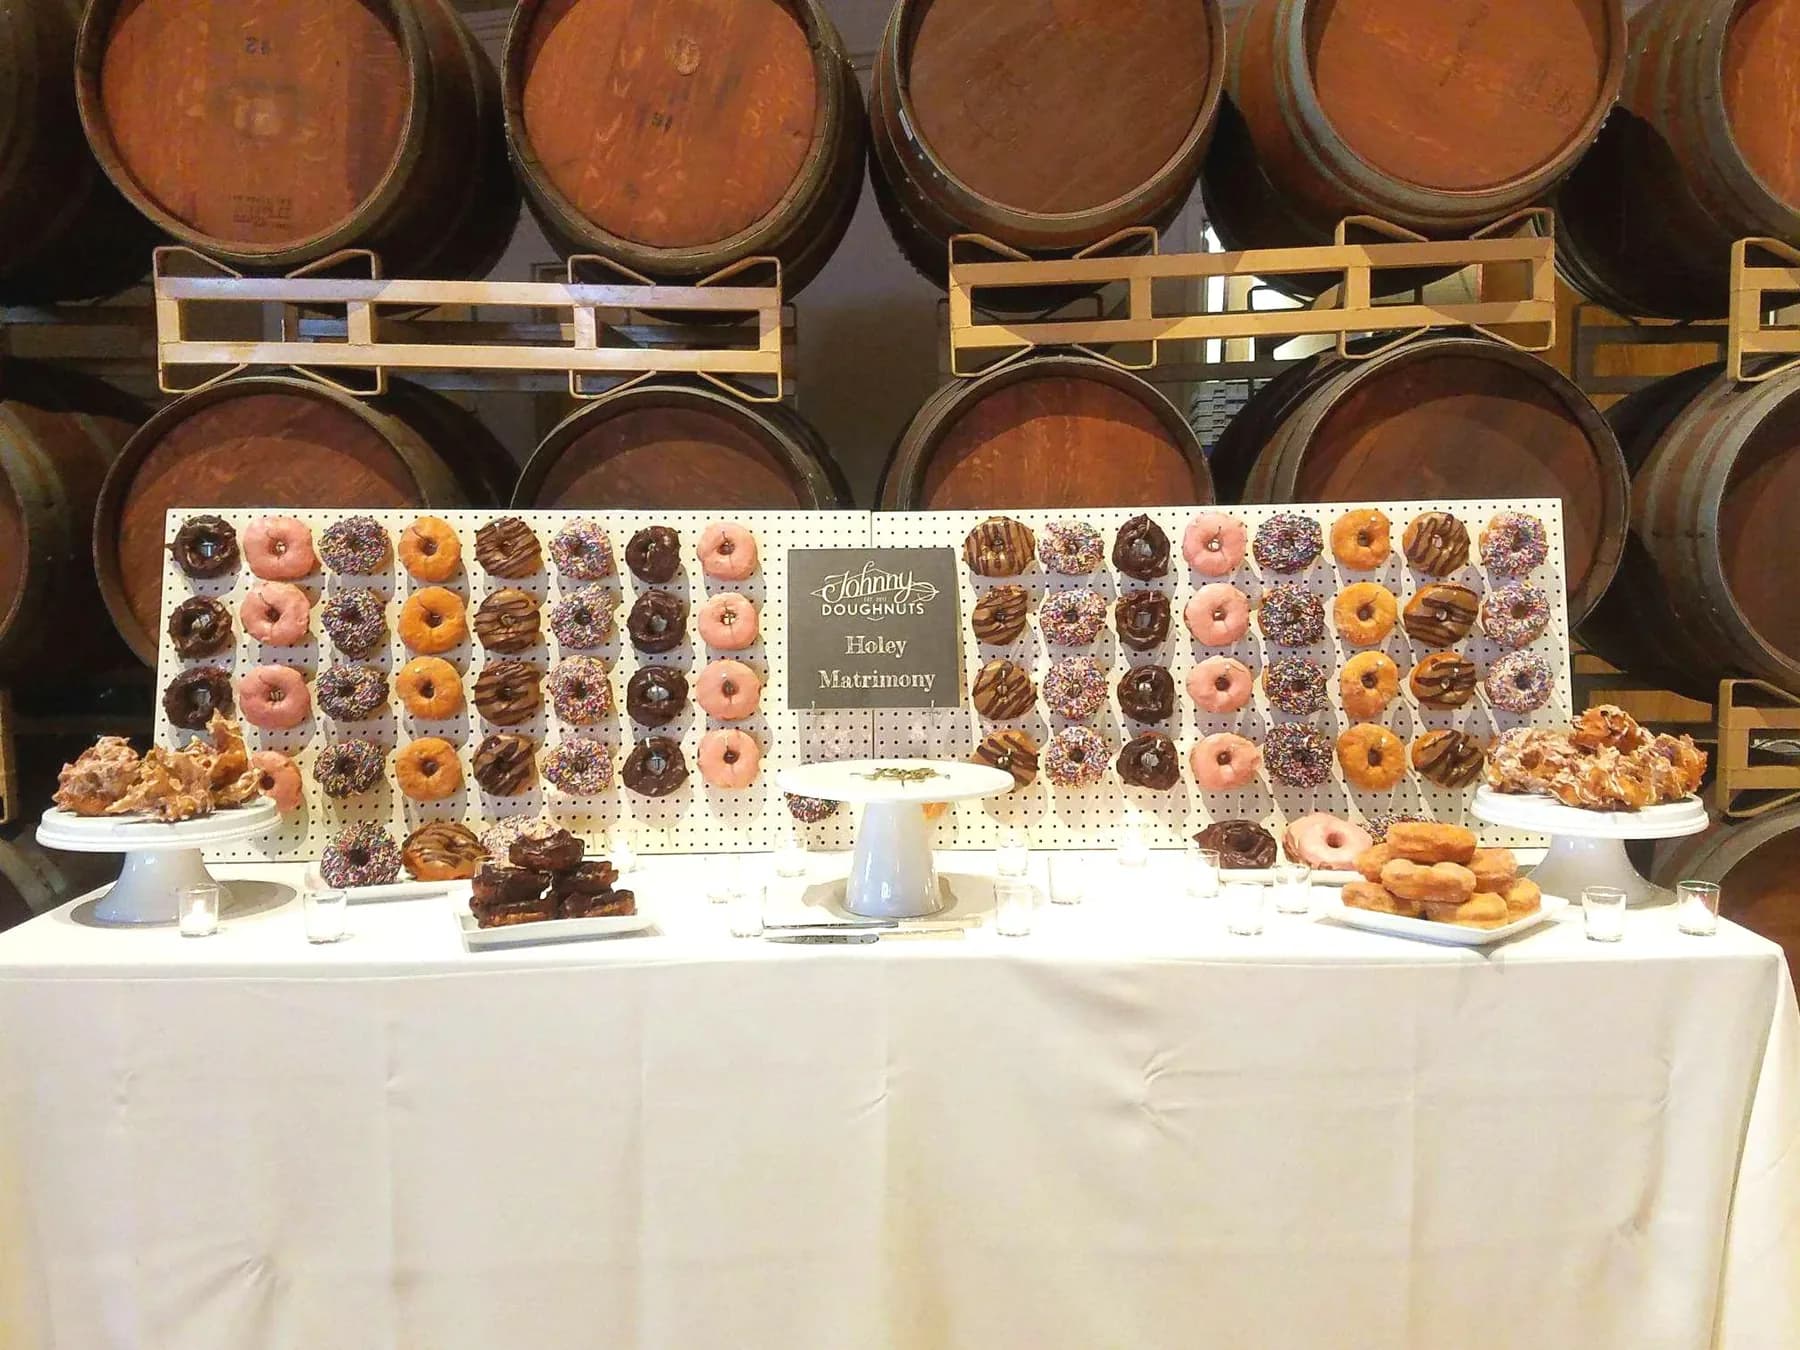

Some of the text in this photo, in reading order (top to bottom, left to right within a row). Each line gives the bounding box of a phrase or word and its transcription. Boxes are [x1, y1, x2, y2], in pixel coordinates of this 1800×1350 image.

[822, 561, 913, 603] Johnny
[822, 603, 925, 616] DOUGHNUTS
[845, 636, 907, 658] Holey
[818, 670, 936, 692] Matrimony
